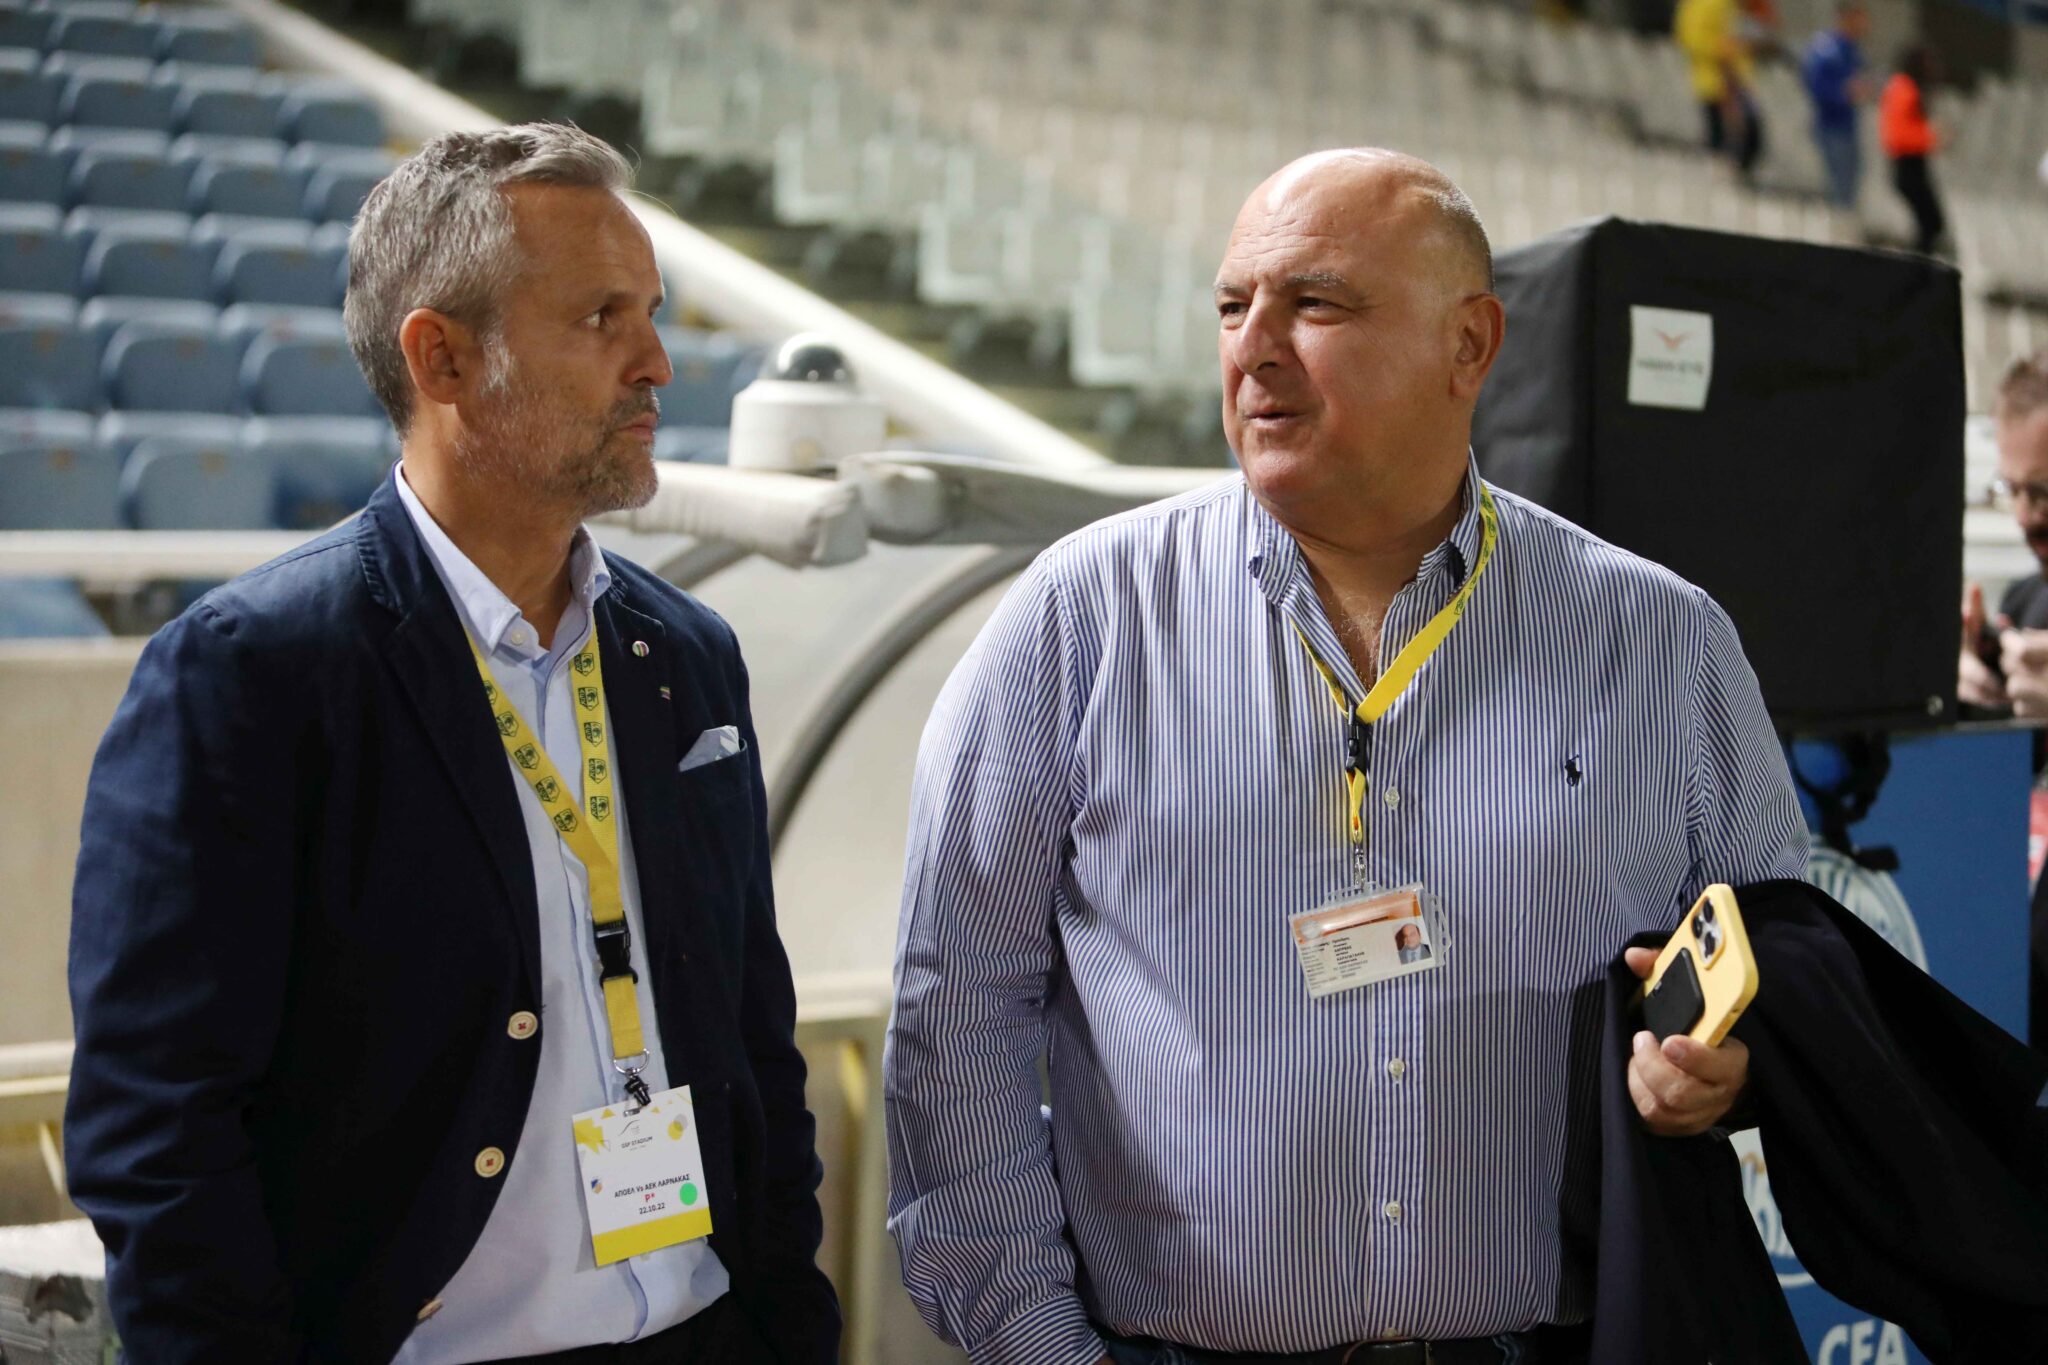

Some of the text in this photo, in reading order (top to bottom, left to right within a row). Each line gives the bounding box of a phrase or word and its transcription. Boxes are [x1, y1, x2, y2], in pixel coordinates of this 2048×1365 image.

[614, 1187, 635, 1198] ΑΠΟΕΛ
[645, 1182, 657, 1190] ΑΕΚ
[658, 1174, 690, 1187] ΛΑΡΝΑΚΑΣ
[639, 1203, 665, 1214] 22.10.22
